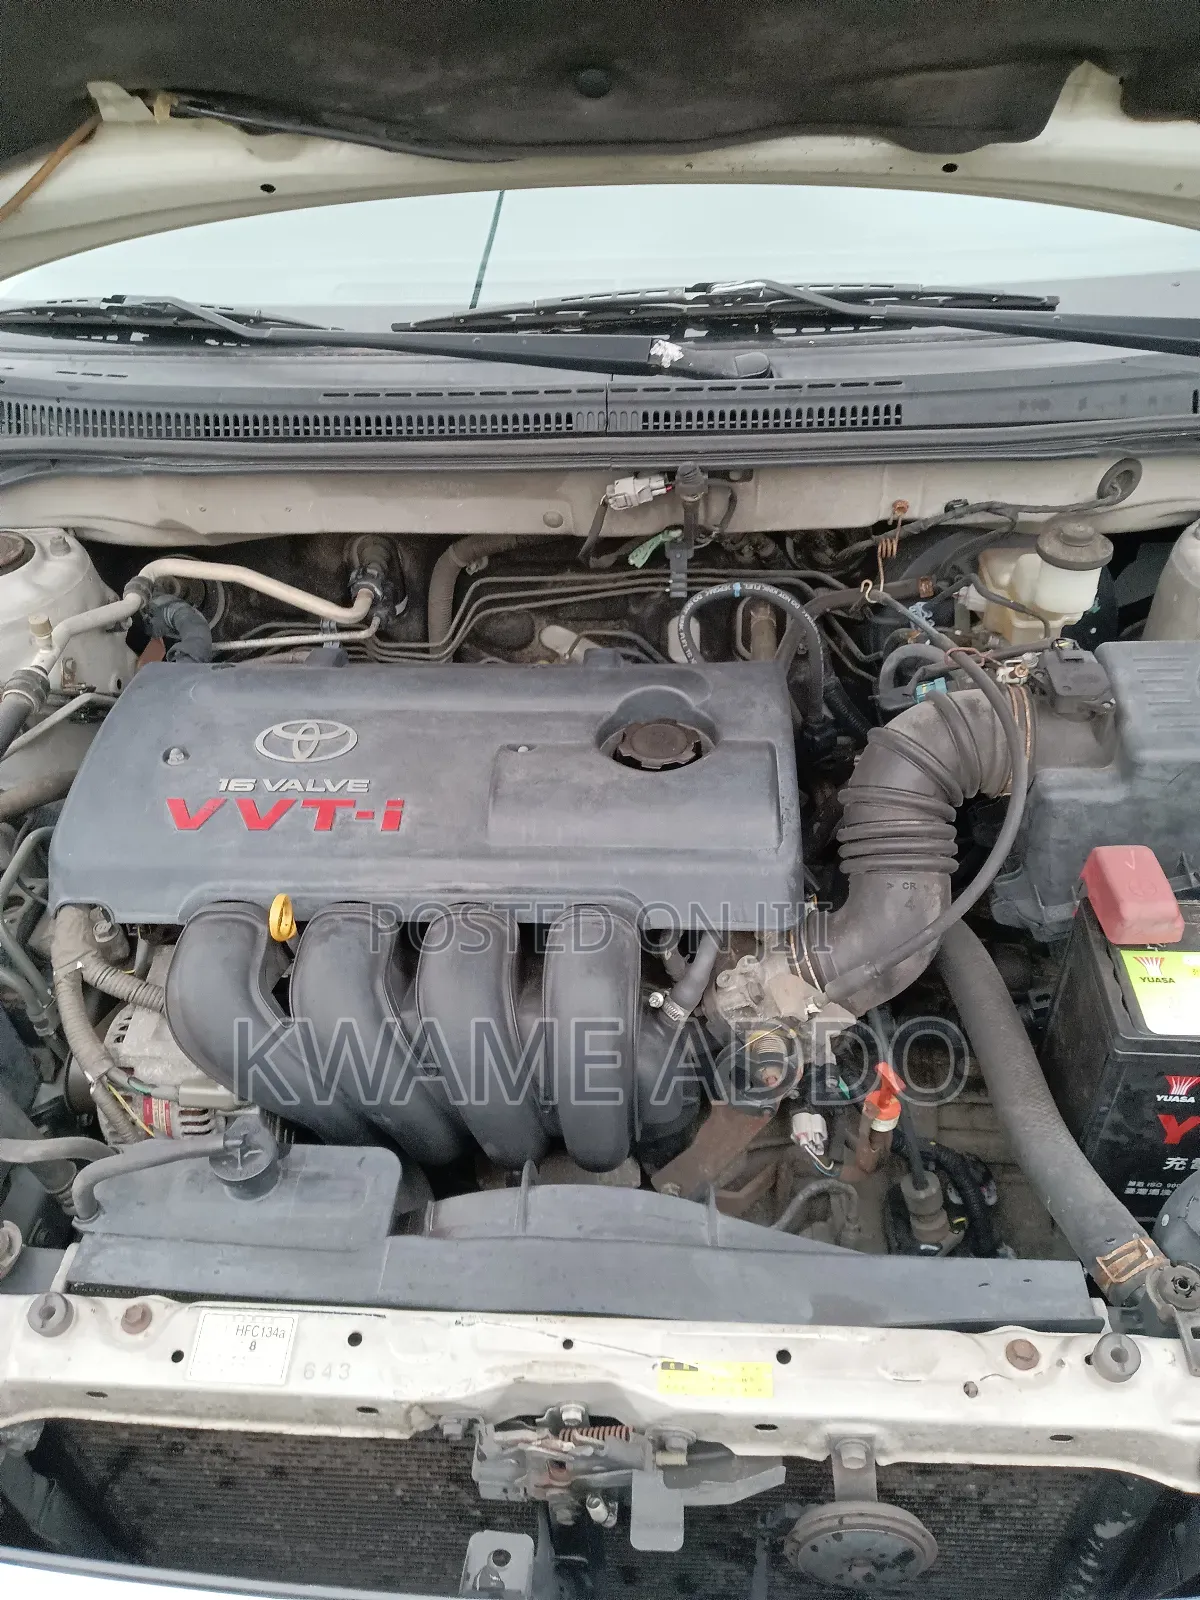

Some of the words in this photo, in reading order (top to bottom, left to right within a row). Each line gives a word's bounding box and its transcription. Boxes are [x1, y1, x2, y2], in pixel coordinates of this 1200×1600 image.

[219, 778, 257, 792] 16
[263, 778, 370, 792] VALVE
[166, 797, 404, 831] VVT-i
[902, 882, 917, 890] CR
[1139, 976, 1176, 984] YUASA
[1156, 1094, 1195, 1103] YUASA
[235, 1324, 286, 1339] HFC134a
[249, 1340, 257, 1351] 8
